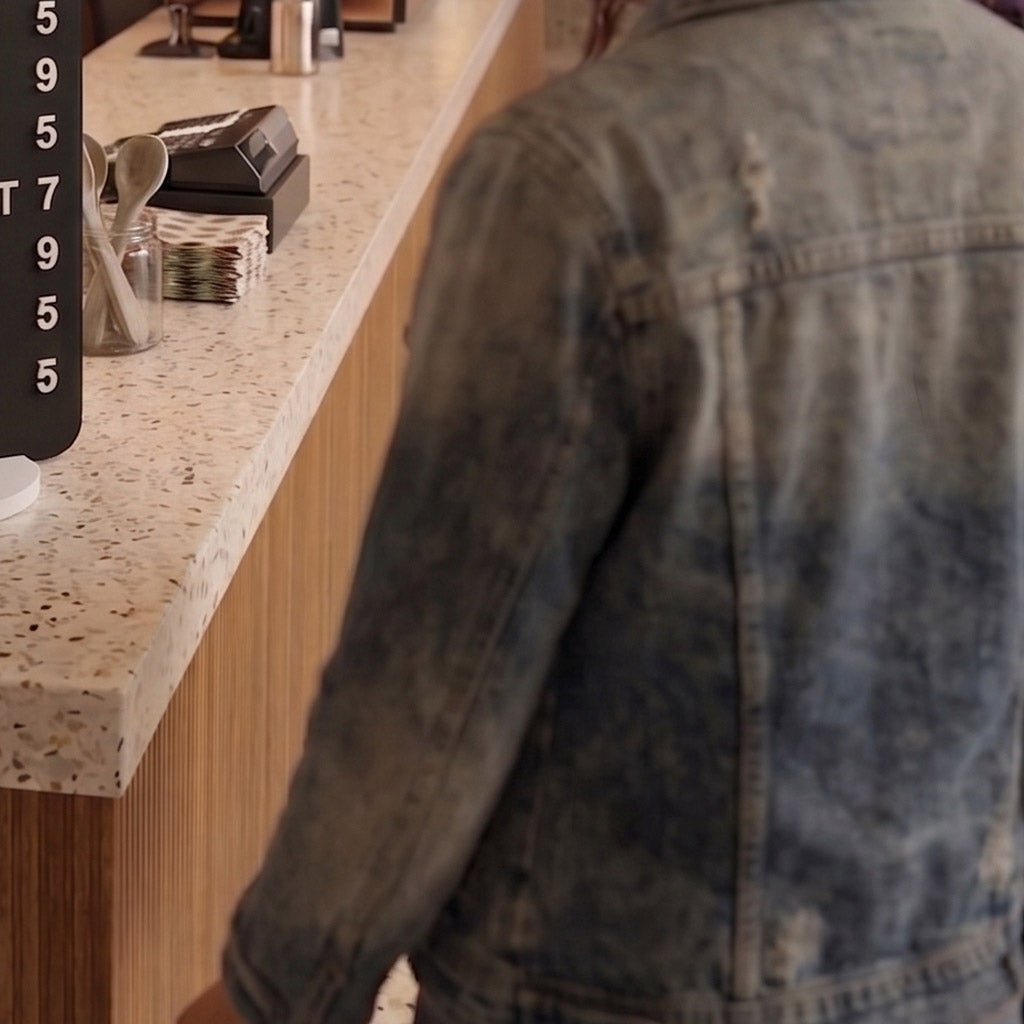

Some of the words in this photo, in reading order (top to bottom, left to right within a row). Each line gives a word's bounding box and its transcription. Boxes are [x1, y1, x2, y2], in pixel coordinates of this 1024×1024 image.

[36, 0, 58, 35] 5
[35, 57, 58, 93] 9
[35, 114, 58, 150] 5
[37, 175, 60, 211] 7
[37, 235, 59, 270] 9
[36, 295, 59, 331] 5
[36, 357, 58, 394] 5
